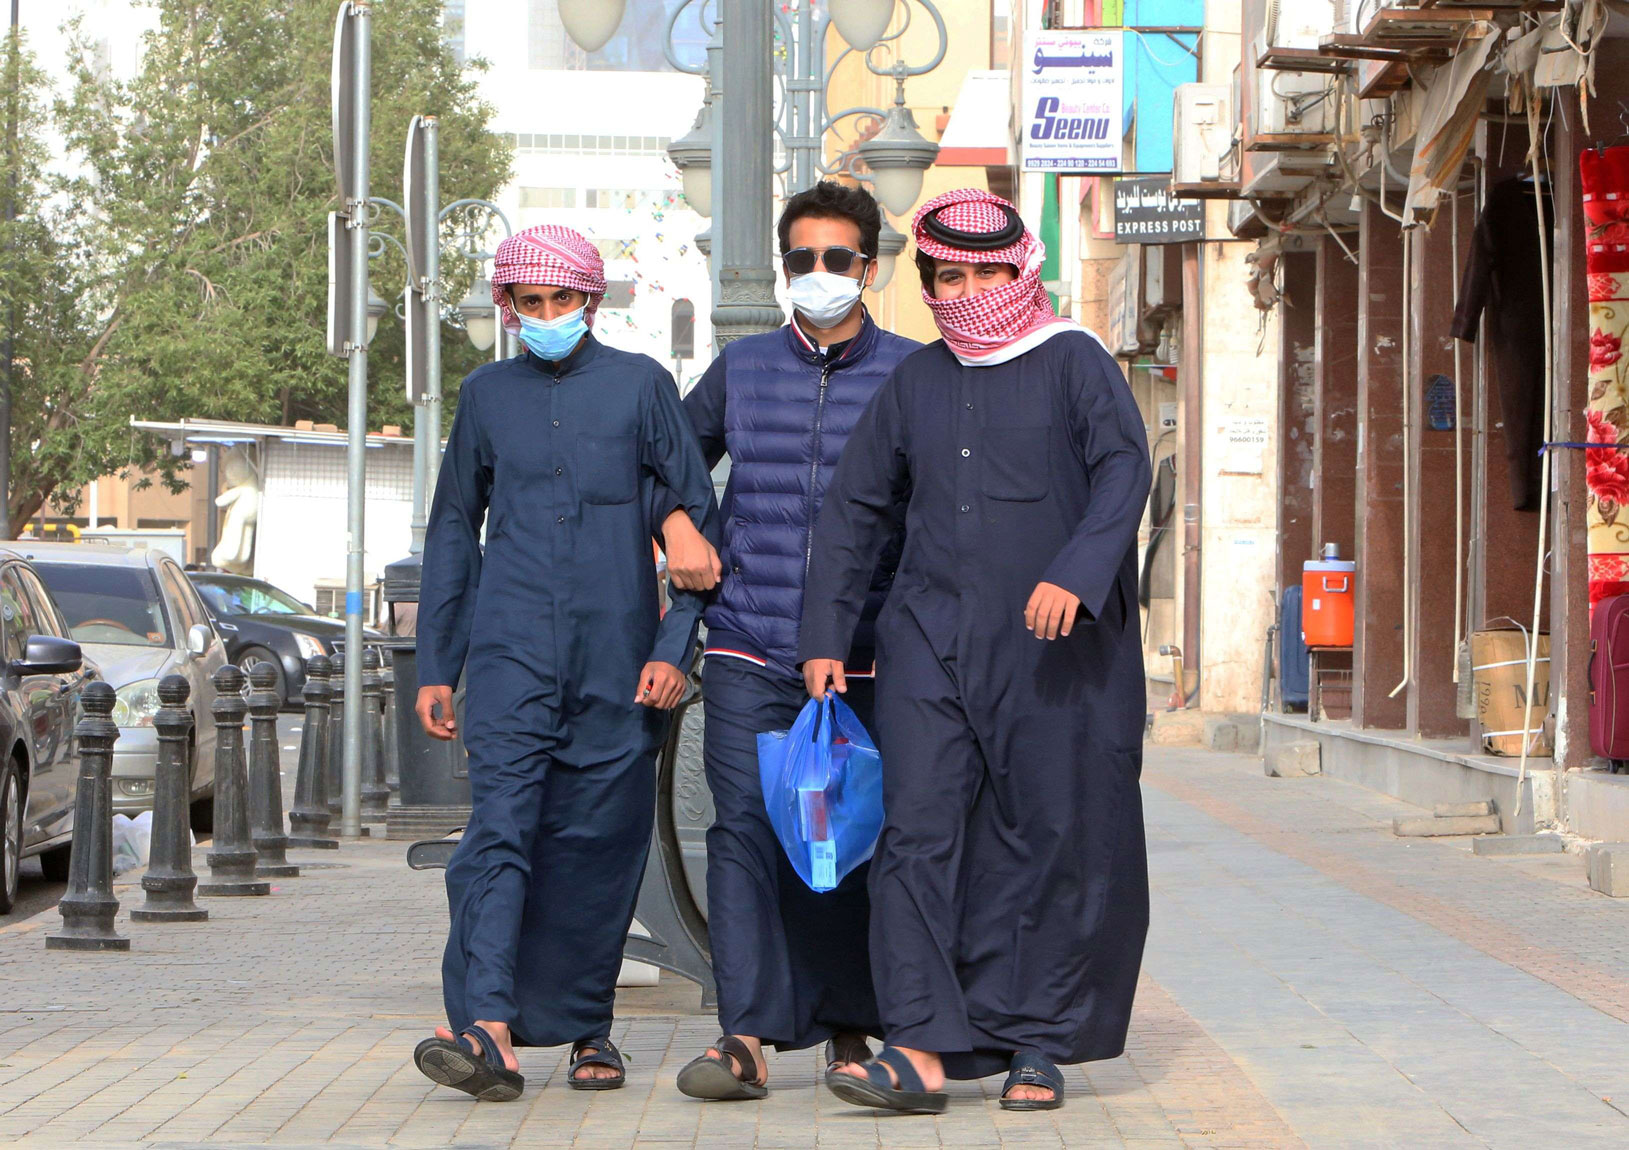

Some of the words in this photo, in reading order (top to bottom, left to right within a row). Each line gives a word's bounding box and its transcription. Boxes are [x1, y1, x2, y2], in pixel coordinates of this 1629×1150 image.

[1032, 44, 1113, 75] سينو
[1030, 96, 1110, 140] Seenu
[1117, 220, 1169, 234] EXPRESS
[1172, 219, 1201, 232] POST
